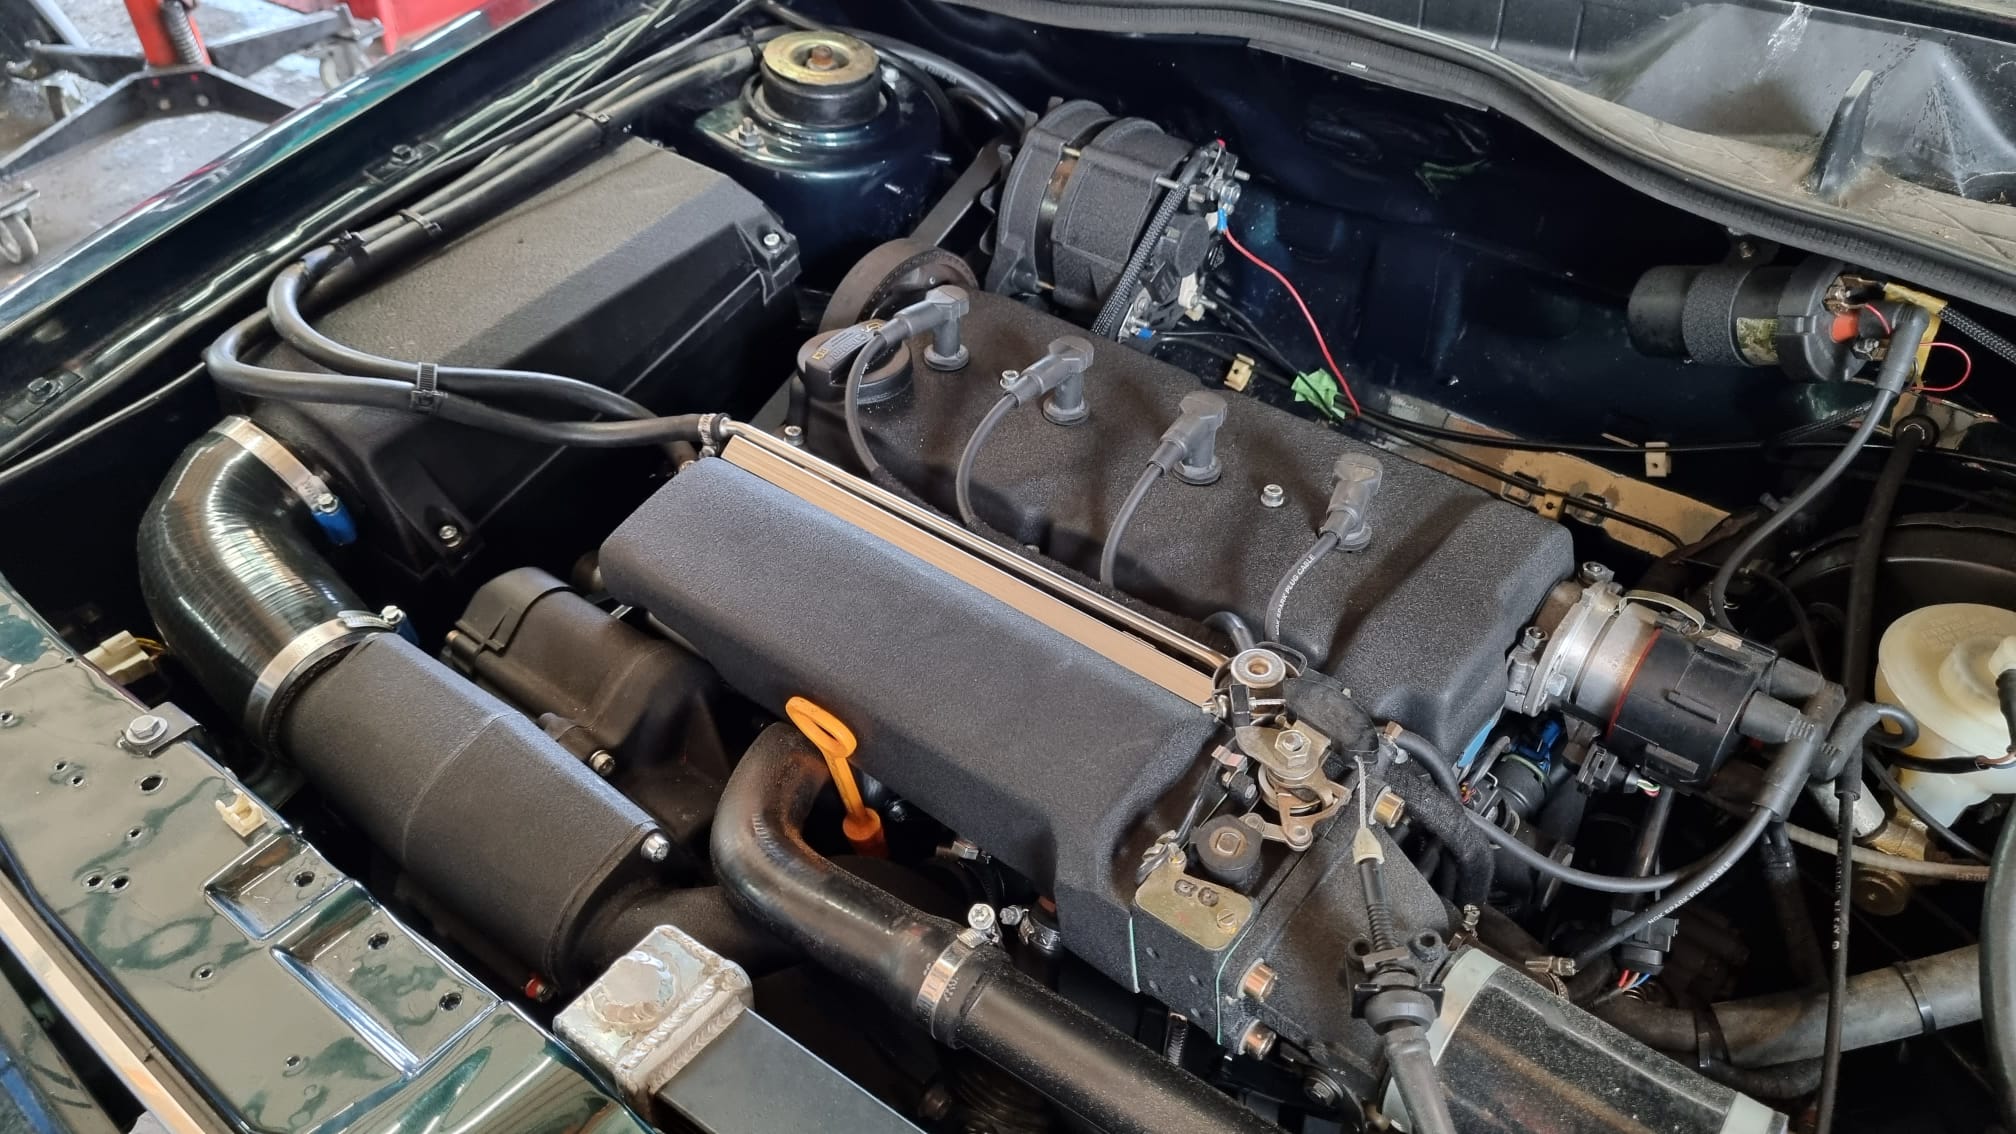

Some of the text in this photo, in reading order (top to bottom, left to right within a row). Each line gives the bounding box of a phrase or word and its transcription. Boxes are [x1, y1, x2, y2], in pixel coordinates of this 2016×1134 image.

[1276, 593, 1288, 618] SPARK
[1285, 574, 1299, 595] PLUG
[1297, 553, 1316, 576] CABLE
[1647, 860, 1732, 924] NGK SPARK PLUG CABLE
